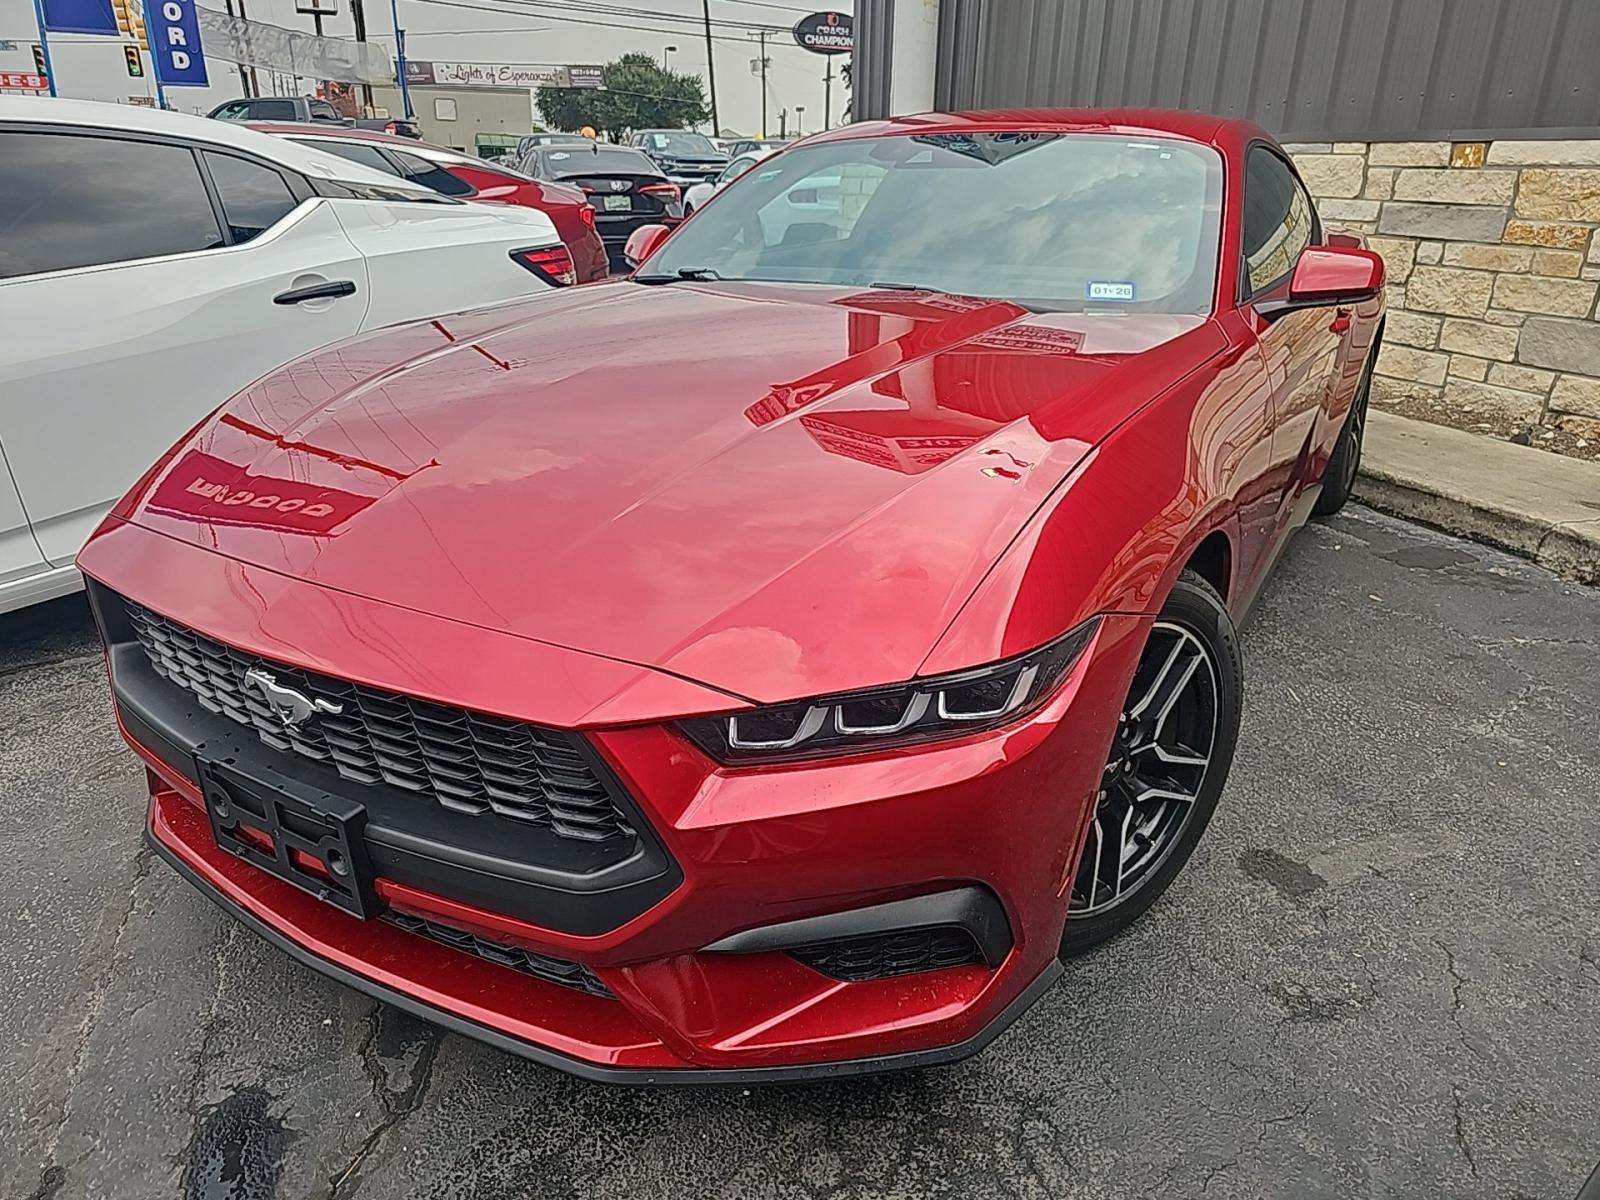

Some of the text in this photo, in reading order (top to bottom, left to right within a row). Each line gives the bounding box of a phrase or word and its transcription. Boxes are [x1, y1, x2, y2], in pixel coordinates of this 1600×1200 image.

[162, 0, 191, 70] ORD
[816, 26, 849, 35] CRASH
[450, 65, 484, 85] Lights
[486, 66, 497, 85] of
[500, 66, 554, 87] Esperanza
